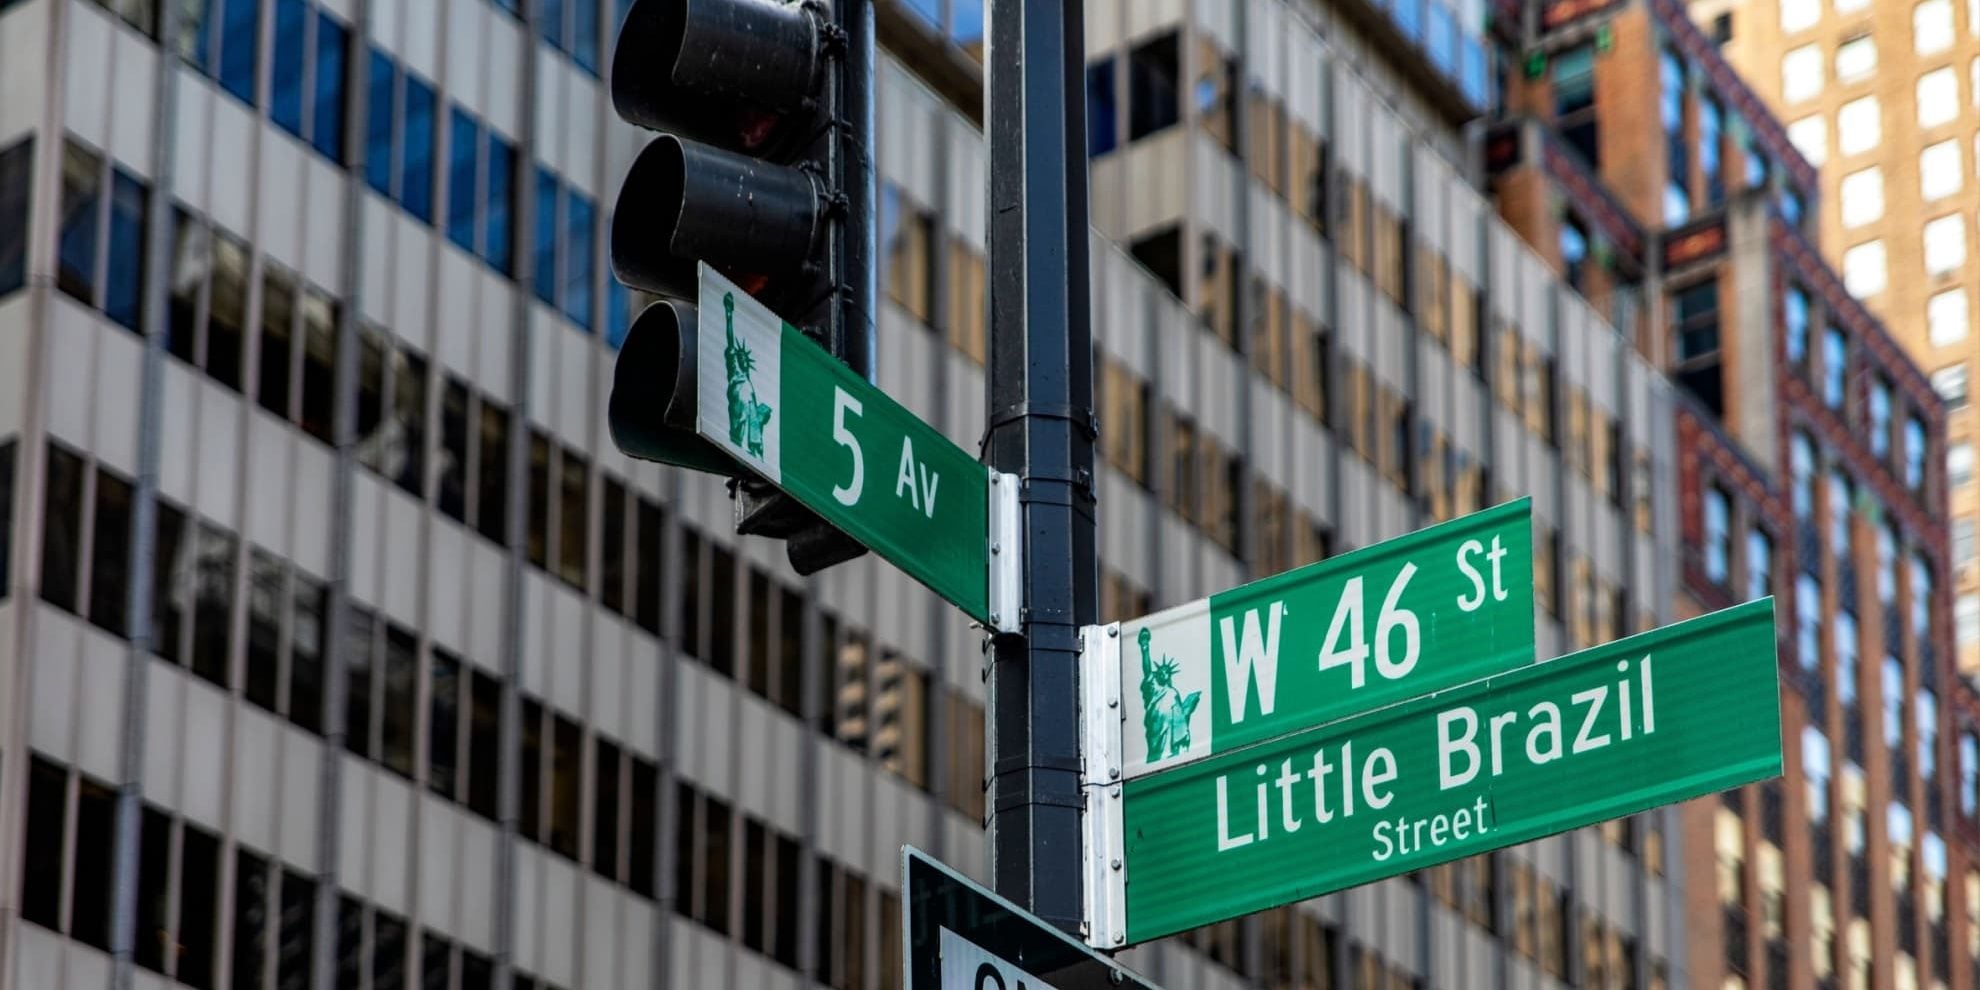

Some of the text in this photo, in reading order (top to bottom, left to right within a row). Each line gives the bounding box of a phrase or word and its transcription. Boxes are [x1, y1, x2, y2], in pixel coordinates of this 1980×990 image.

[833, 385, 865, 506] 5
[1219, 534, 1508, 724] W 46 St
[1216, 653, 1655, 852] Little Brazil
[1372, 796, 1488, 861] Street
